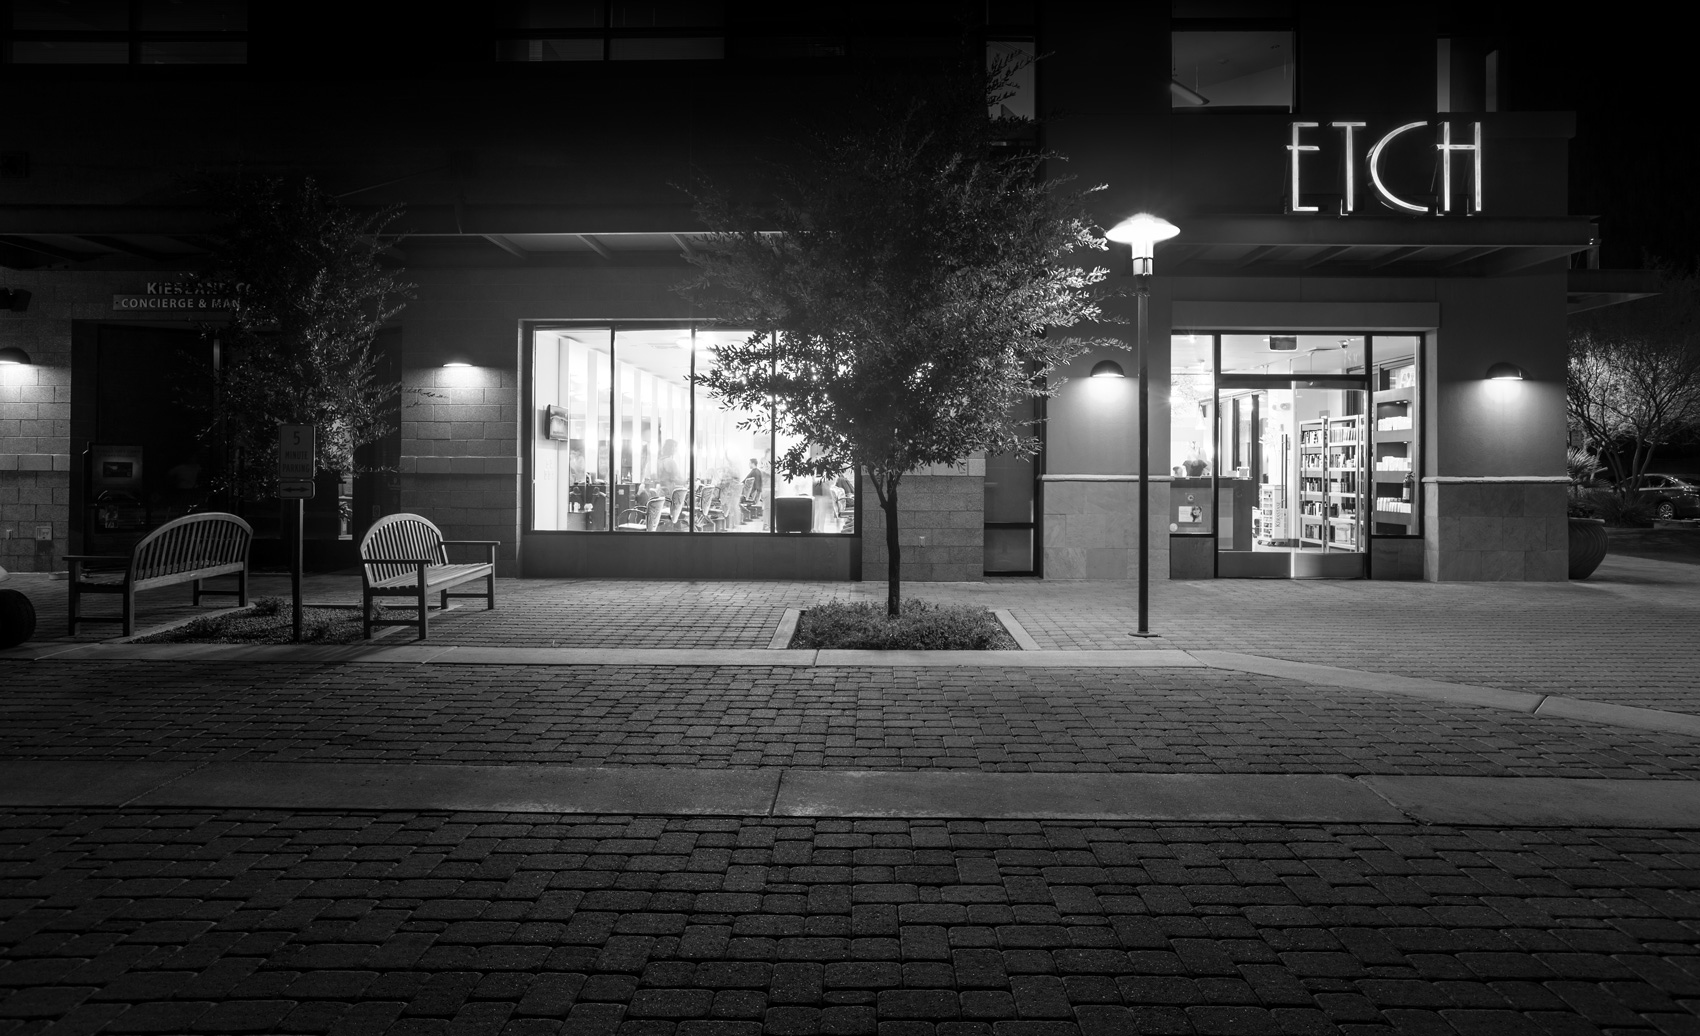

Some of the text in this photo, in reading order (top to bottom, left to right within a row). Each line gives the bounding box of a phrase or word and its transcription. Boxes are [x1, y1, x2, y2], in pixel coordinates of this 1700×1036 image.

[1286, 121, 1482, 213] ETCH
[121, 298, 194, 308] CONCIERGE
[198, 298, 207, 308] &
[293, 431, 300, 445] 5
[285, 451, 309, 460] MINUTE
[282, 464, 310, 473] PARKING
